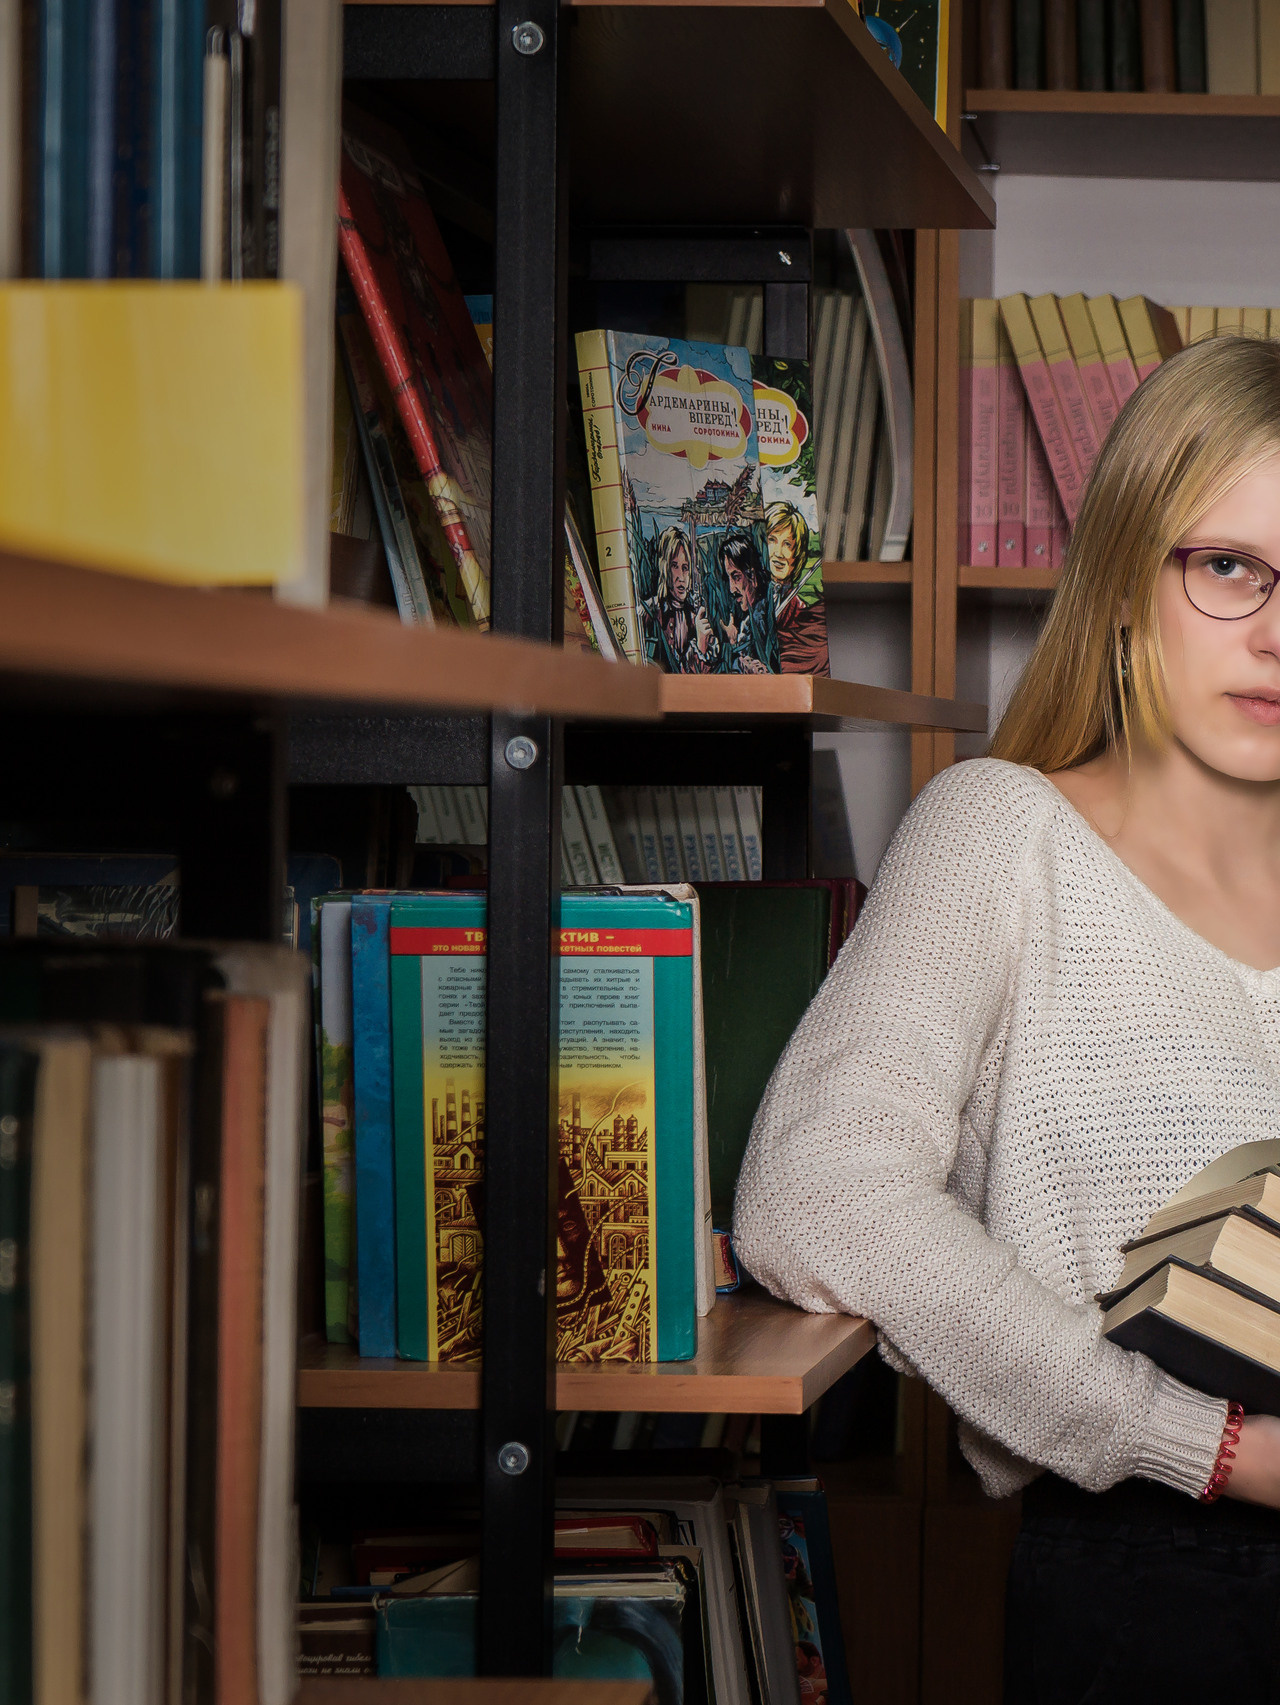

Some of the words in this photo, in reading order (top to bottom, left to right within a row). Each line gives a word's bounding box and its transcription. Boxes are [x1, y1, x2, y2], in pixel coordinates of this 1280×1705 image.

[689, 407, 738, 428] ВПЕРЕД!
[651, 423, 671, 433] НИНА
[693, 427, 740, 439] СОРОТОКИНА
[605, 547, 612, 557] 2
[465, 931, 487, 942] ТВ
[432, 944, 449, 952] это
[451, 944, 481, 952] новая
[596, 944, 642, 952] повестей
